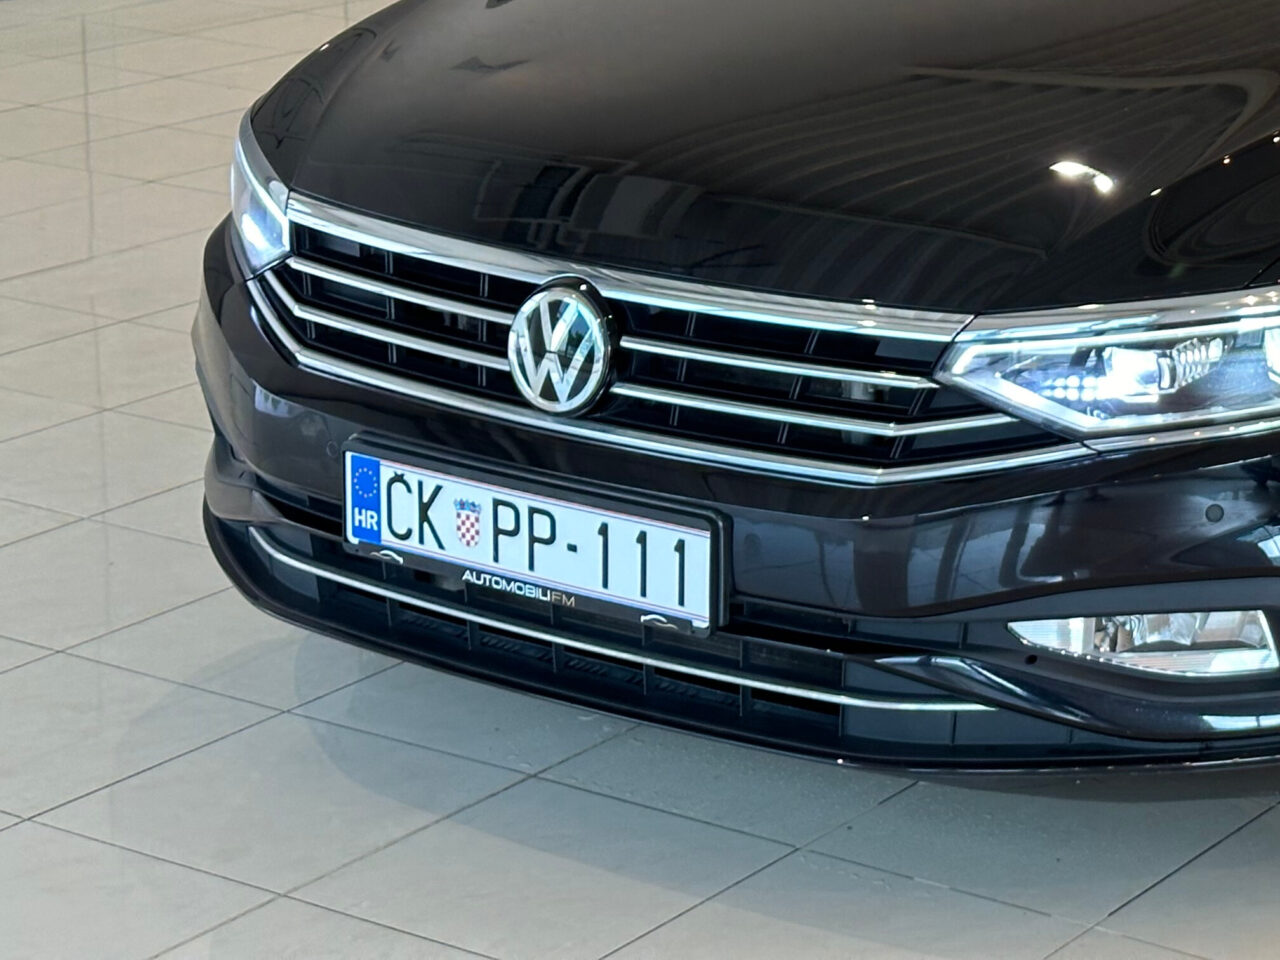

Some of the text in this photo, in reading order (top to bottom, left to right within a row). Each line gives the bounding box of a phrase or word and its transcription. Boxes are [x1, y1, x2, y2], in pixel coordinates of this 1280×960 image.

[509, 289, 604, 411] VW
[354, 507, 378, 531] HR
[387, 471, 686, 608] ČK PP-111
